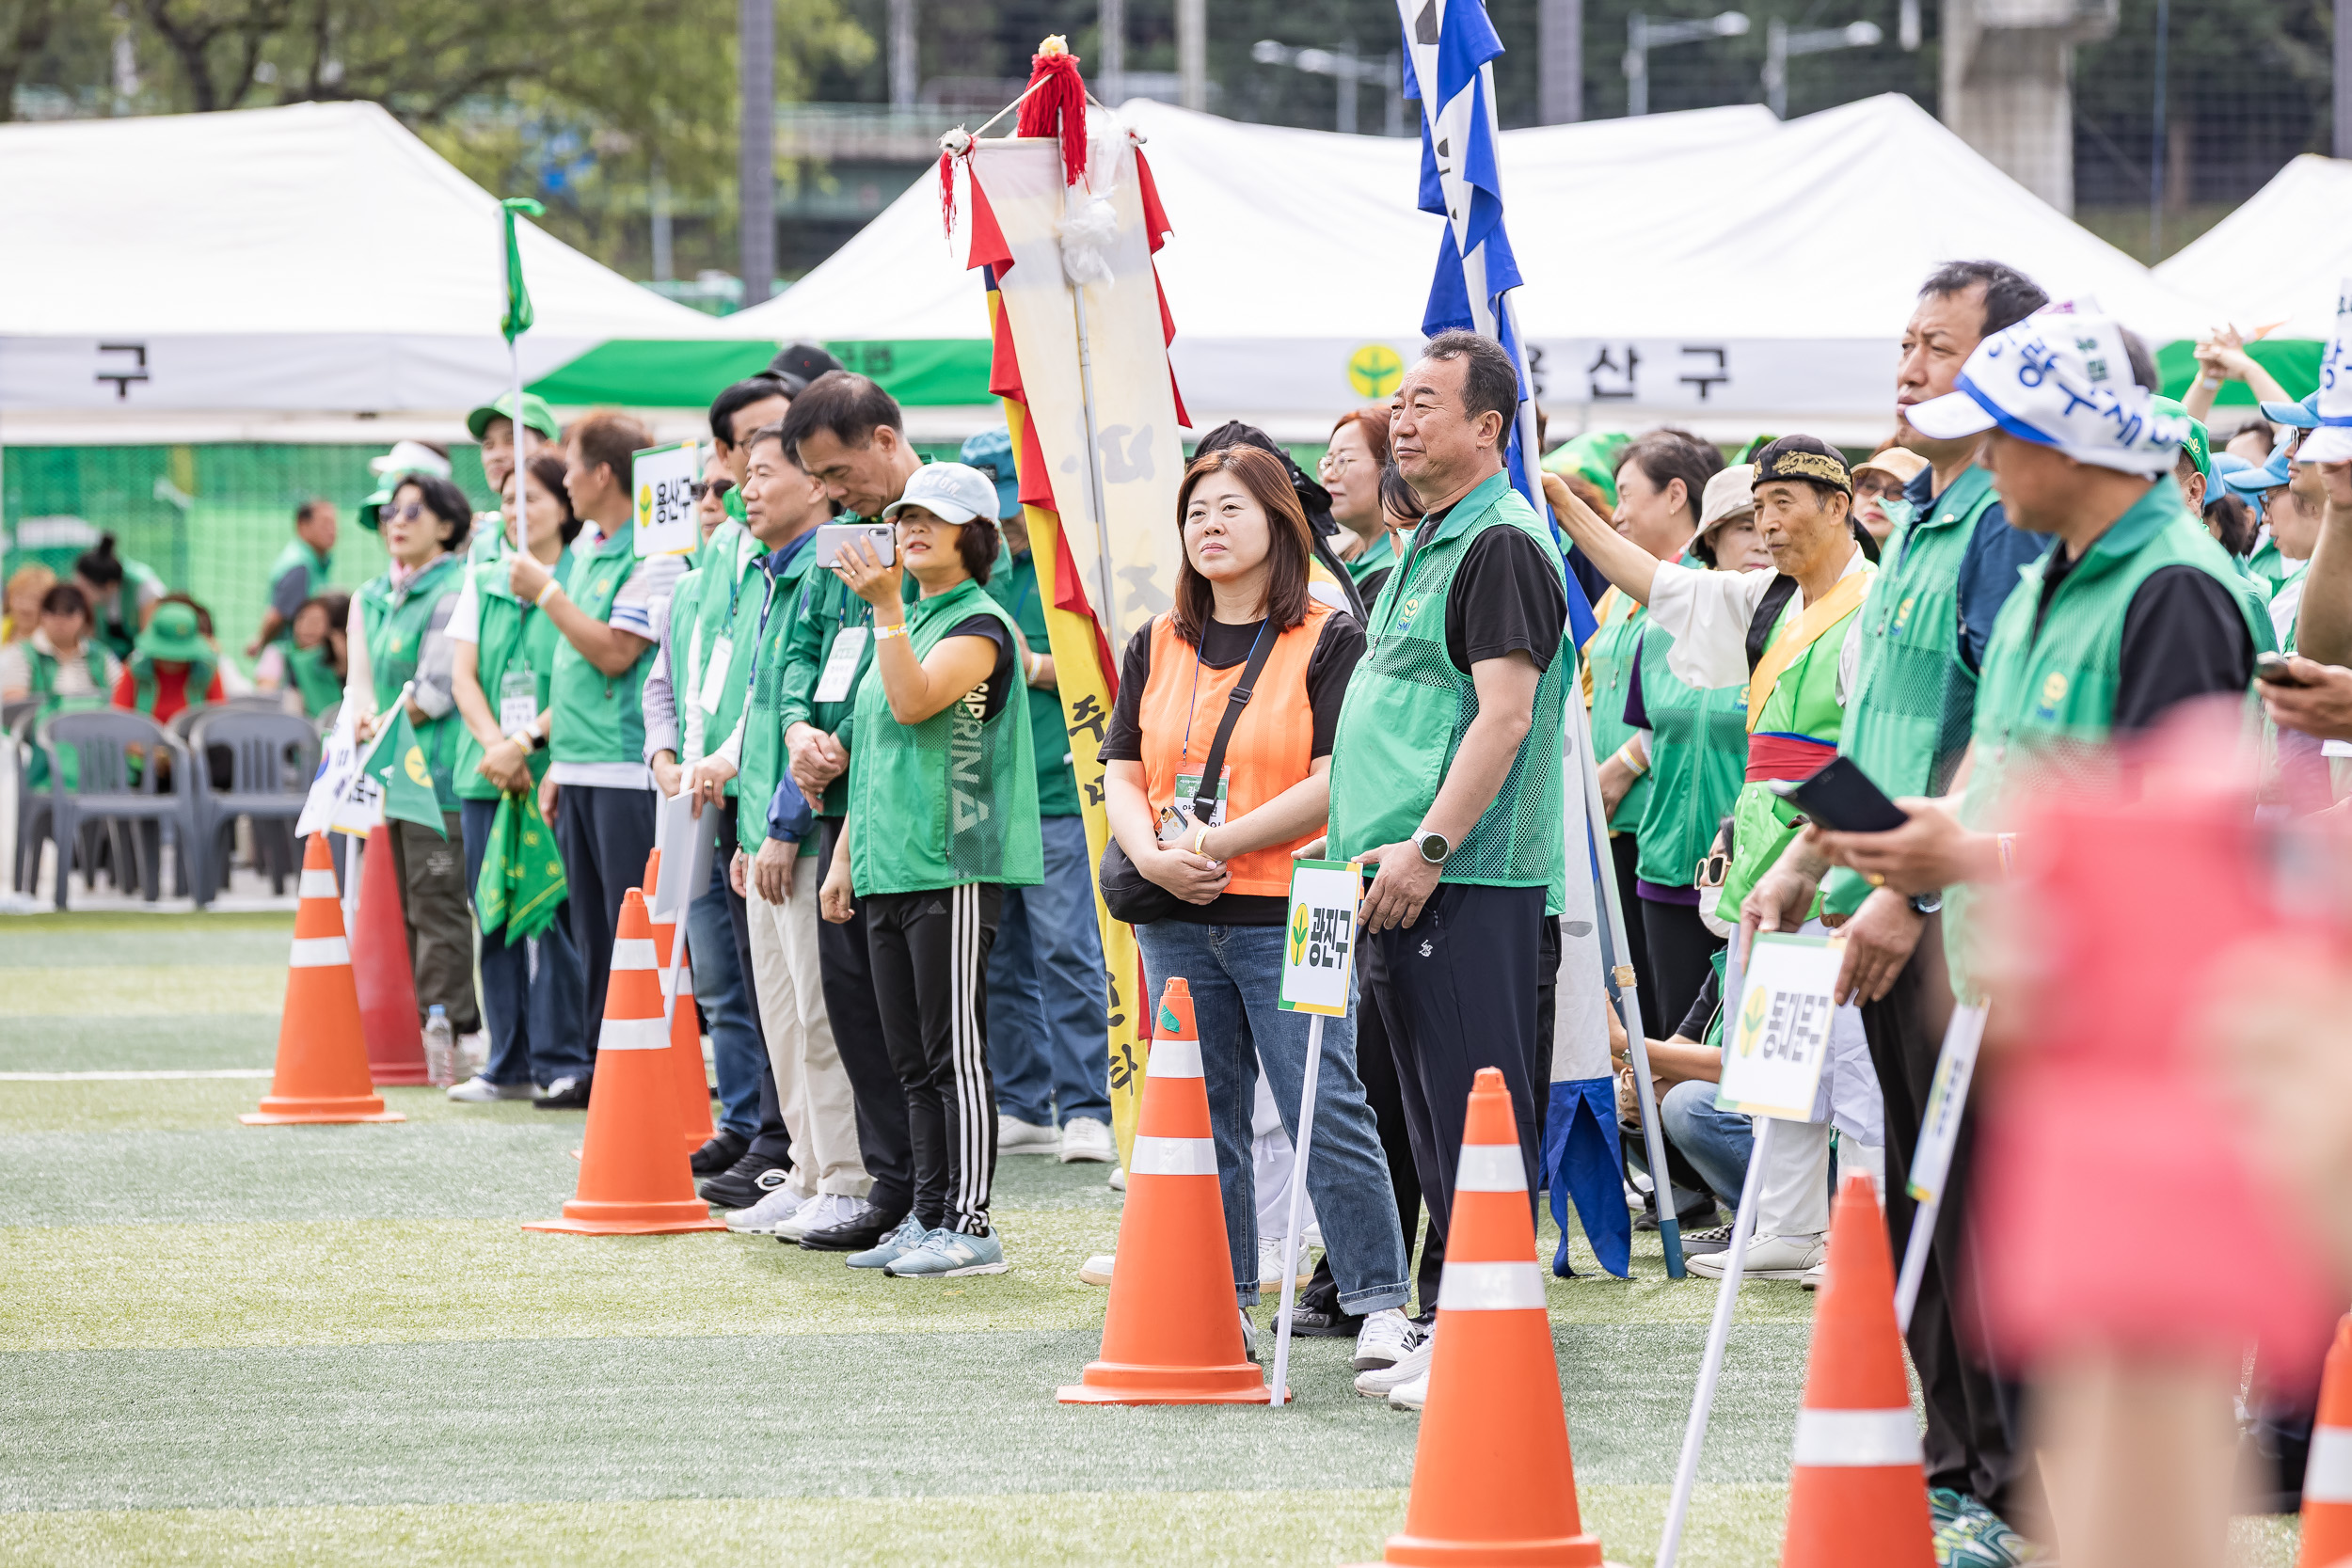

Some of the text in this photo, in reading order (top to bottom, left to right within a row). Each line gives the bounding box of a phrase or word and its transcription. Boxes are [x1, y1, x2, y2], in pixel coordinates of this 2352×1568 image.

[97, 343, 149, 397] 구
[656, 476, 691, 524] 용산구
[1309, 907, 1352, 970] 광진구
[1763, 990, 1829, 1065] 동대문구
